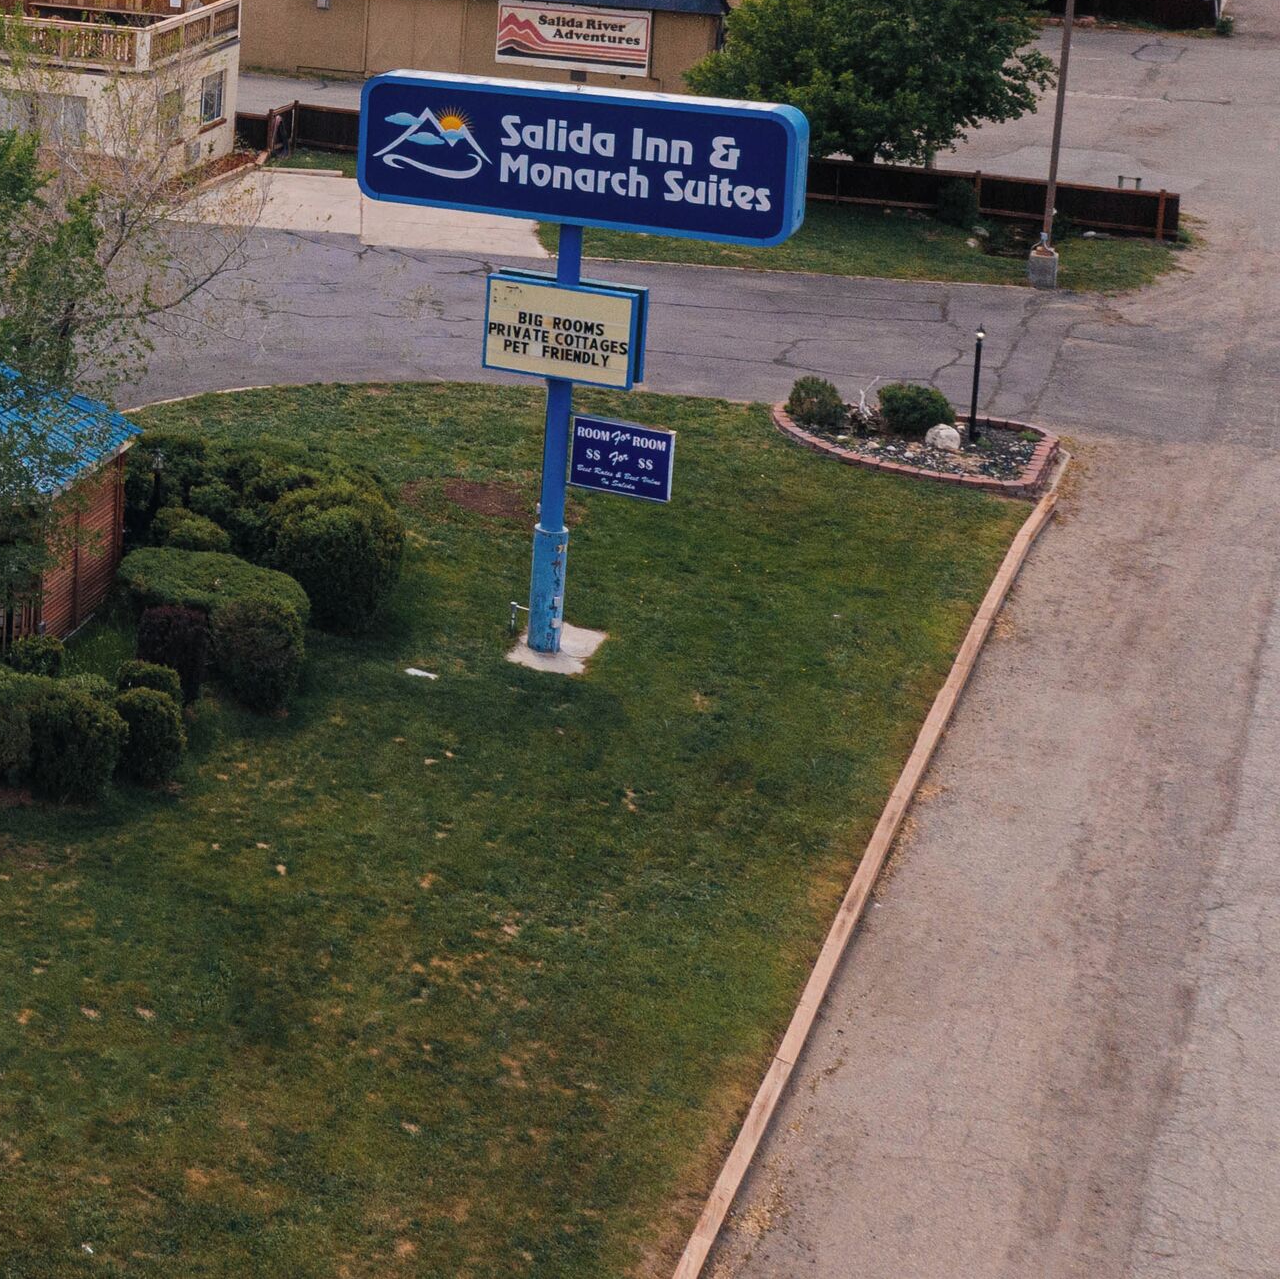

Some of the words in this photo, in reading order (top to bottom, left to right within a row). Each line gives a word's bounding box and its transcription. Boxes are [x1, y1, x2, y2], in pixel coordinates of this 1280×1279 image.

[538, 14, 583, 29] Salida
[586, 19, 626, 32] River
[553, 30, 641, 46] Adventures
[500, 115, 615, 157] Salida
[631, 128, 693, 166] Inn
[709, 136, 741, 170] &
[499, 153, 649, 198] Monarch
[664, 171, 772, 212] Suites
[518, 311, 543, 327] BIG
[553, 317, 605, 336] ROOMS
[488, 322, 549, 343] PRIVATE
[555, 333, 628, 355] COTTAGES
[504, 340, 529, 354] PET
[542, 346, 610, 367] FRIENDLY
[577, 427, 610, 441] ROOM
[611, 431, 631, 446] For
[632, 436, 666, 451] ROOM
[608, 451, 629, 466] For
[576, 464, 592, 473] Best
[624, 473, 639, 481] Best
